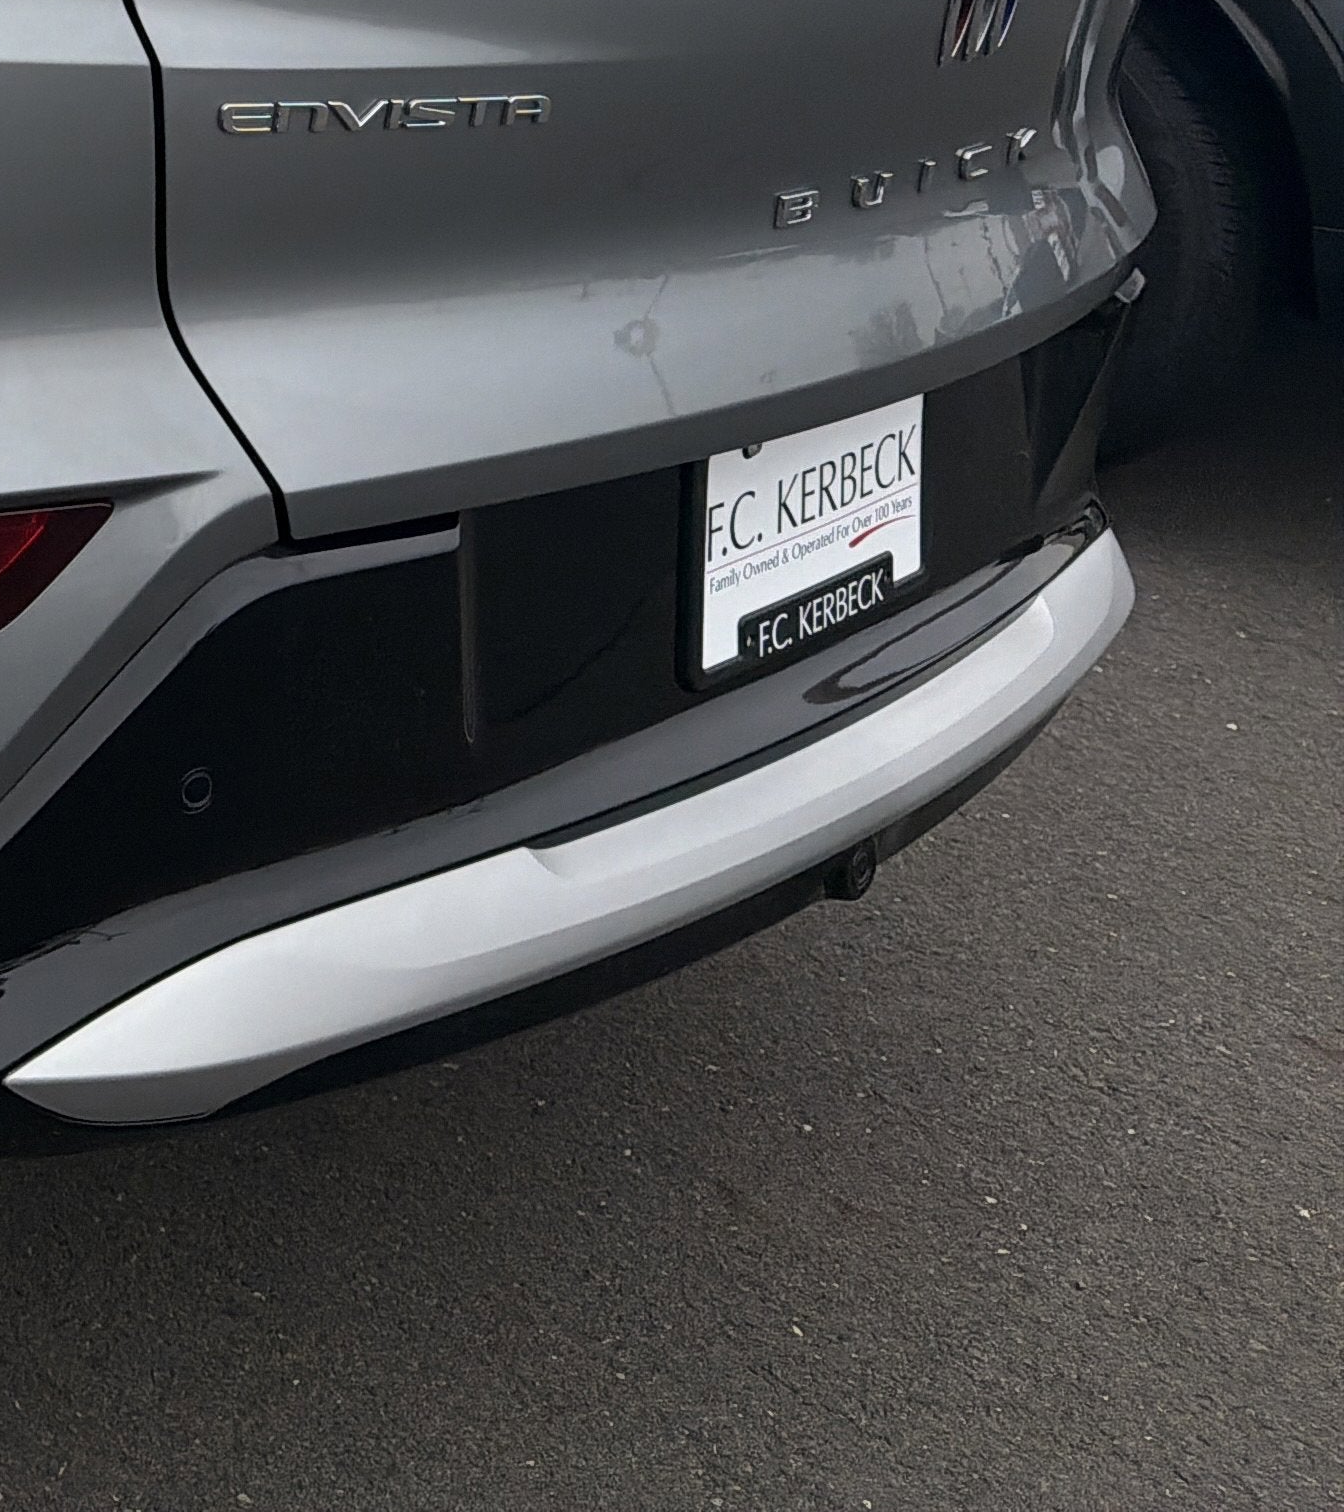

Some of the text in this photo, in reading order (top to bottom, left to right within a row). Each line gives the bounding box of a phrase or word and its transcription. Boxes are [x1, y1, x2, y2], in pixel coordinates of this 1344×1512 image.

[218, 94, 551, 134] ENVISTA
[773, 127, 1038, 230] BUICK
[706, 423, 917, 562] F.C. KERBECK
[709, 495, 913, 595] Family Owned & Operated For Over 100 Years
[758, 567, 885, 658] F.C. KERBECK
